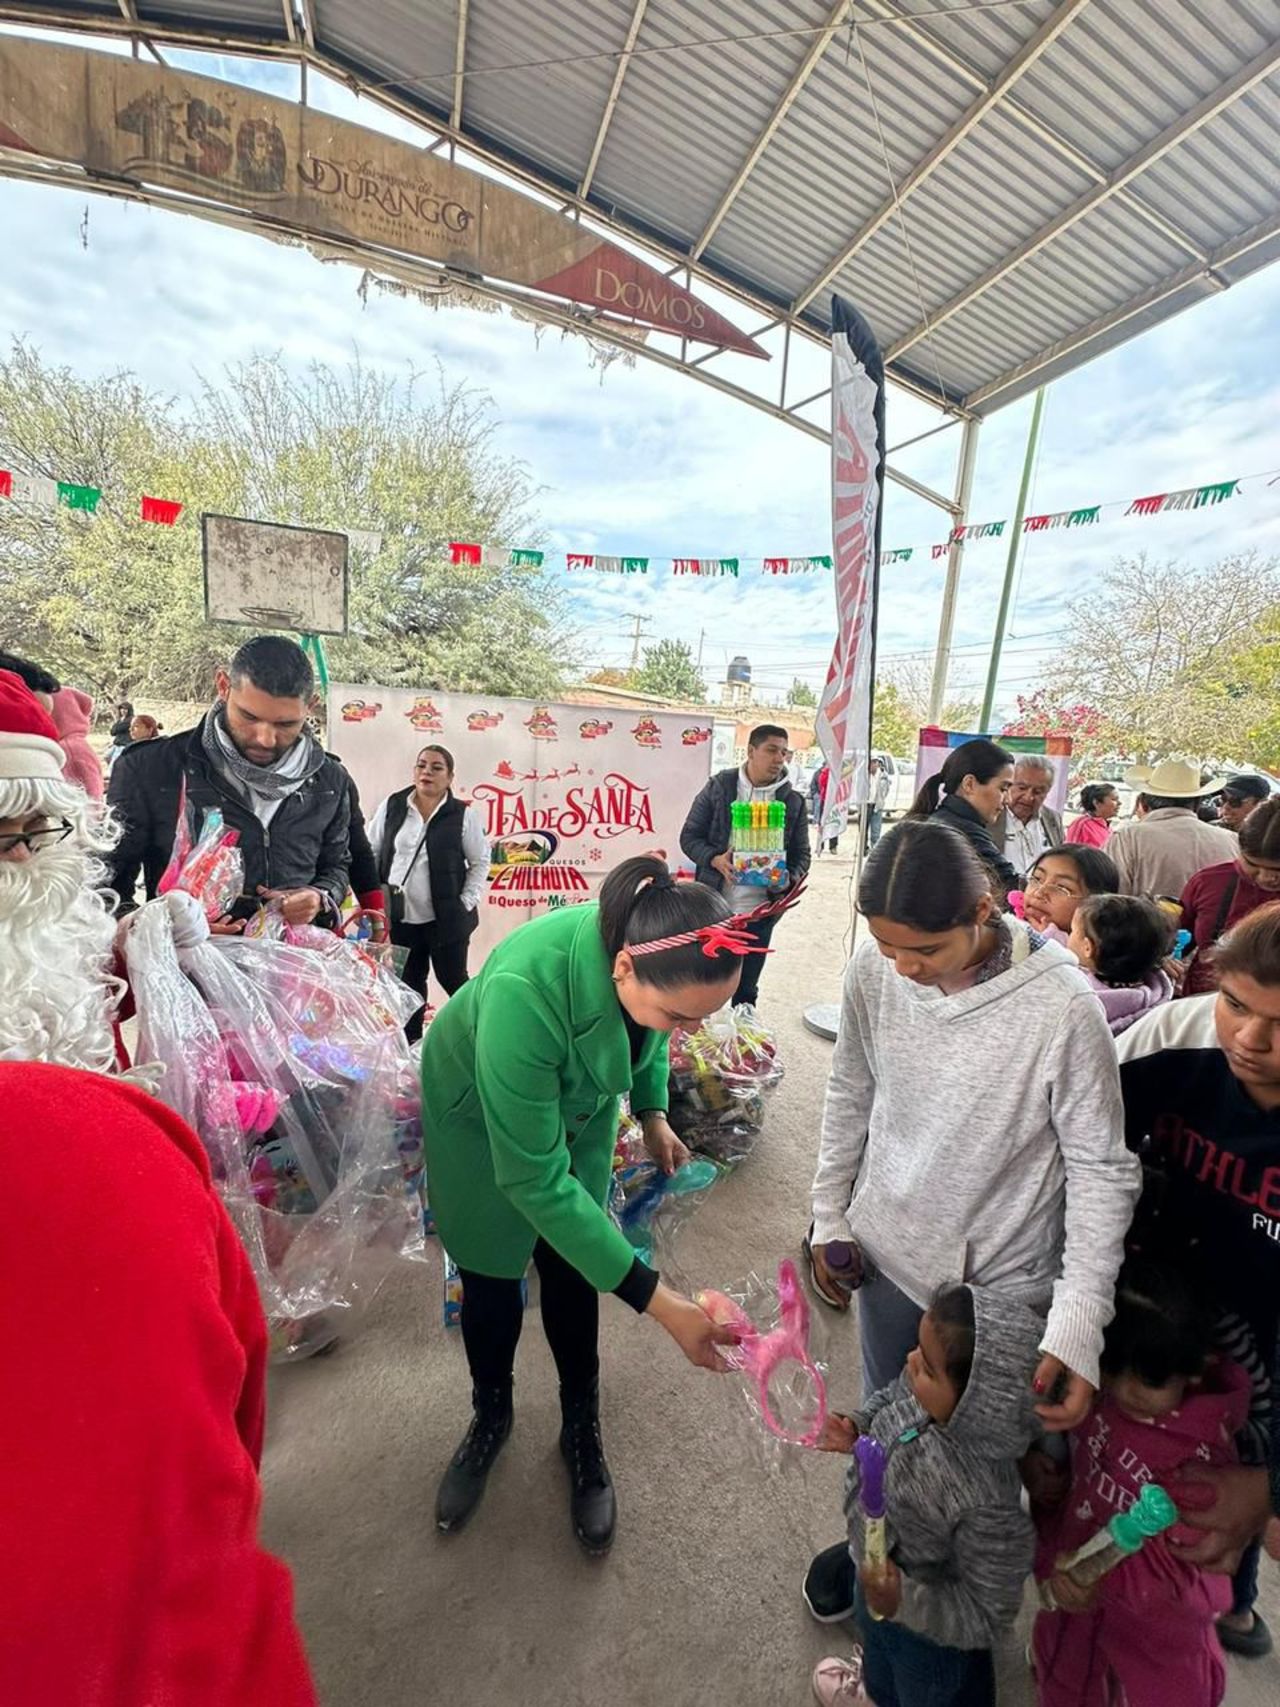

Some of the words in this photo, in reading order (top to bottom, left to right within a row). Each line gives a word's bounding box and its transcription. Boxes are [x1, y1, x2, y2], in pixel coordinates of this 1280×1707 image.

[297, 156, 475, 233] DURANGO
[594, 268, 705, 330] DOMOS
[532, 806, 560, 830] DE
[557, 773, 656, 839] SANTA
[549, 858, 586, 867] QUESOS
[497, 896, 537, 908] Queso
